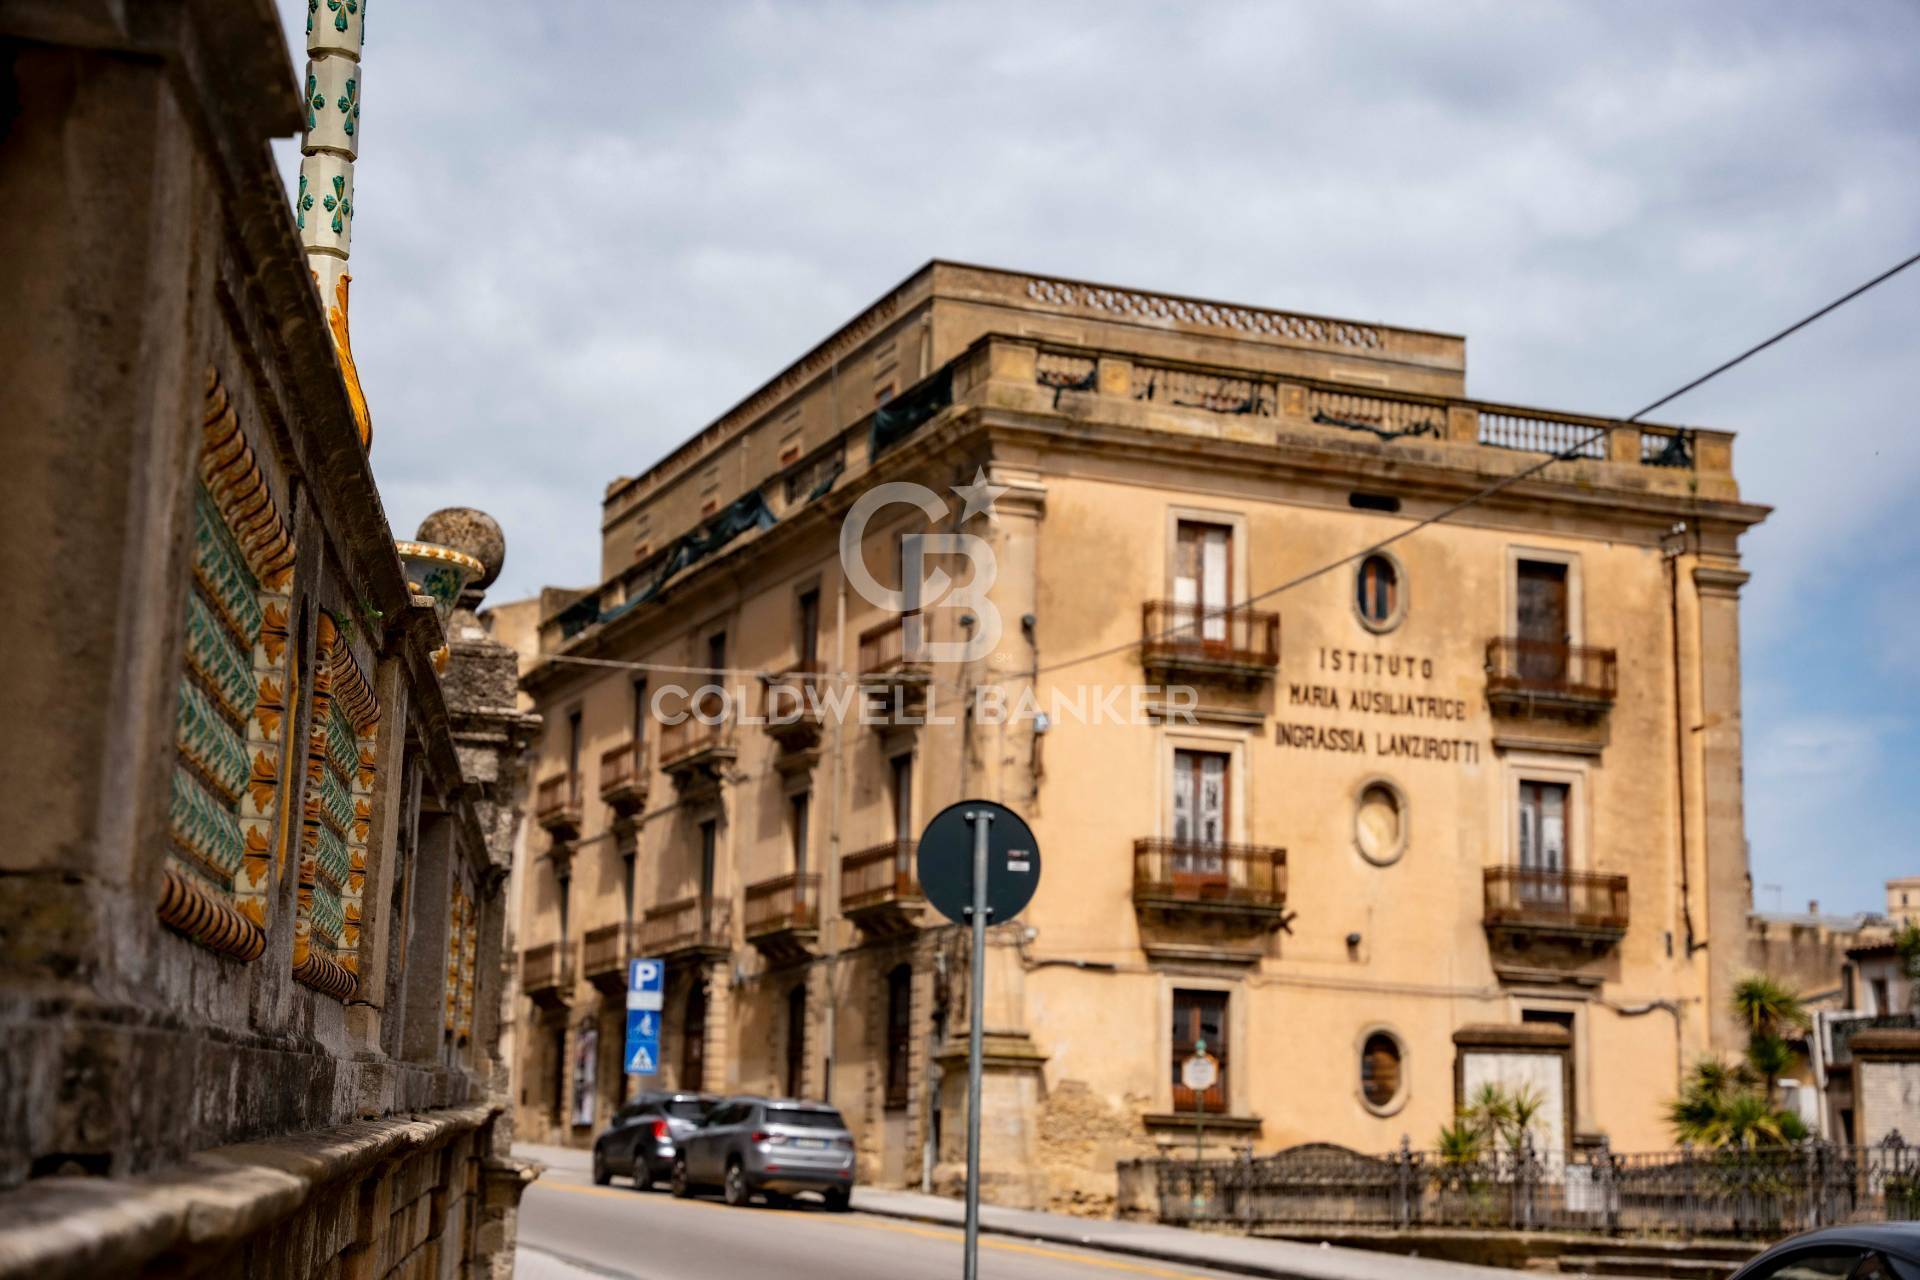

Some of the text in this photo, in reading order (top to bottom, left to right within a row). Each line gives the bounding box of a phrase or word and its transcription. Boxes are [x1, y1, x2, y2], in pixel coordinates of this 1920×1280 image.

[1319, 648, 1433, 680] ISTITUTO
[1289, 683, 1466, 721] MARIA AUSILIATRICE
[1275, 722, 1480, 764] INGRASSIA LANZIROTTI
[634, 962, 658, 991] P
